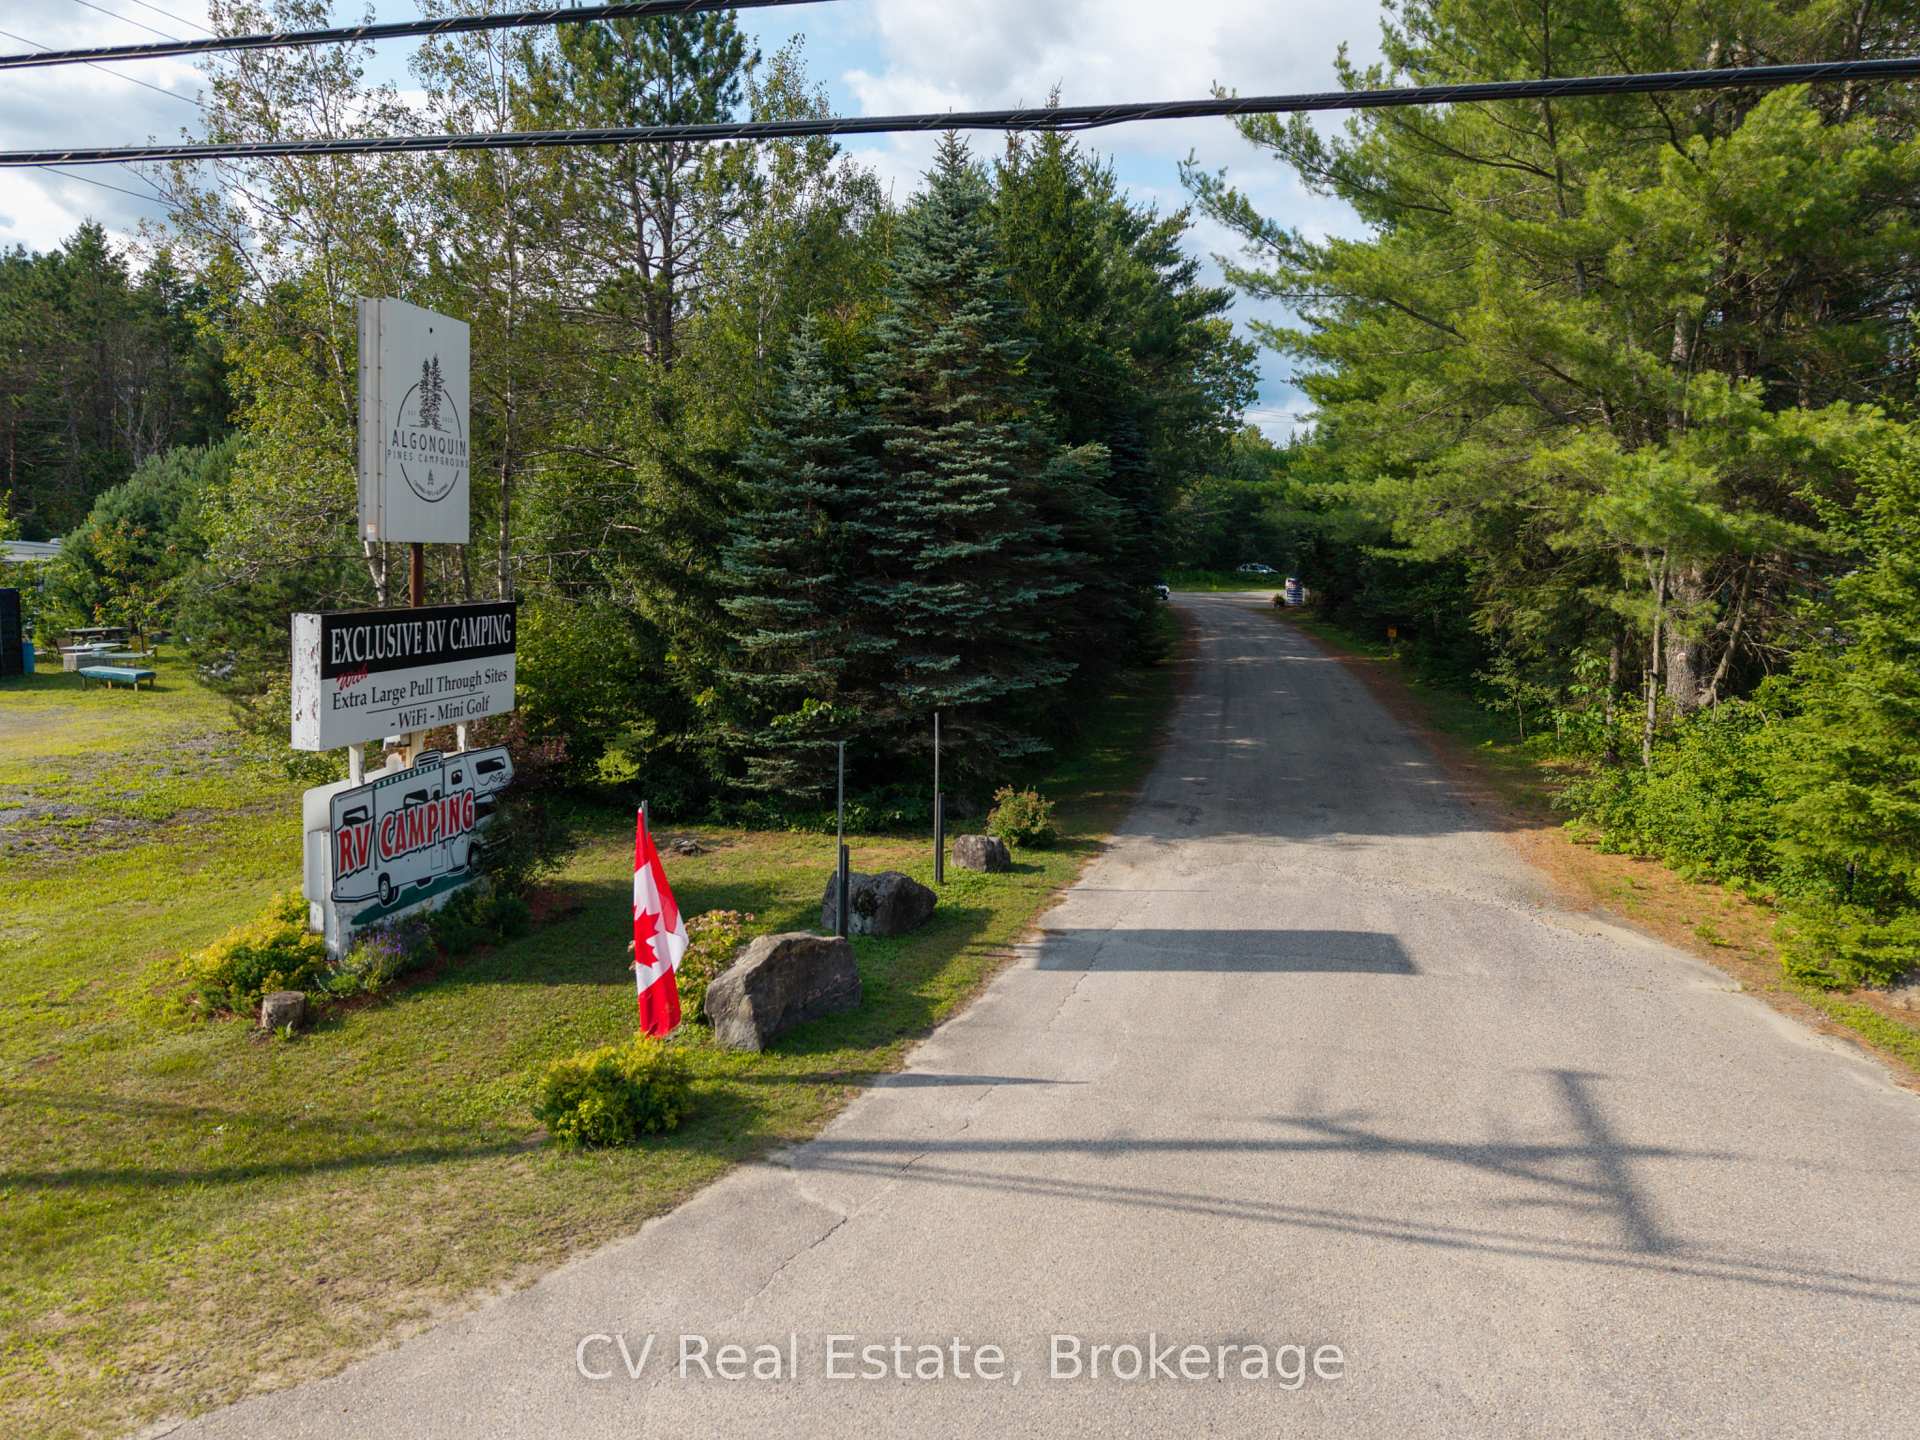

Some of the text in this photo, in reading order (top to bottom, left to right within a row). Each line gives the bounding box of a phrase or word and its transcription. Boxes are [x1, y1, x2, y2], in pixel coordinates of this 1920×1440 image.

[387, 449, 413, 461] PINES
[392, 429, 466, 457] ALGONQUIN
[330, 613, 512, 665] EXCLUSIVE RV CAMPING
[332, 668, 508, 710] Extra Large Pull Through Sites
[398, 708, 427, 729] WiFi
[437, 701, 464, 722] Mini
[467, 695, 491, 715] Golf
[337, 788, 476, 876] RV CAMPING
